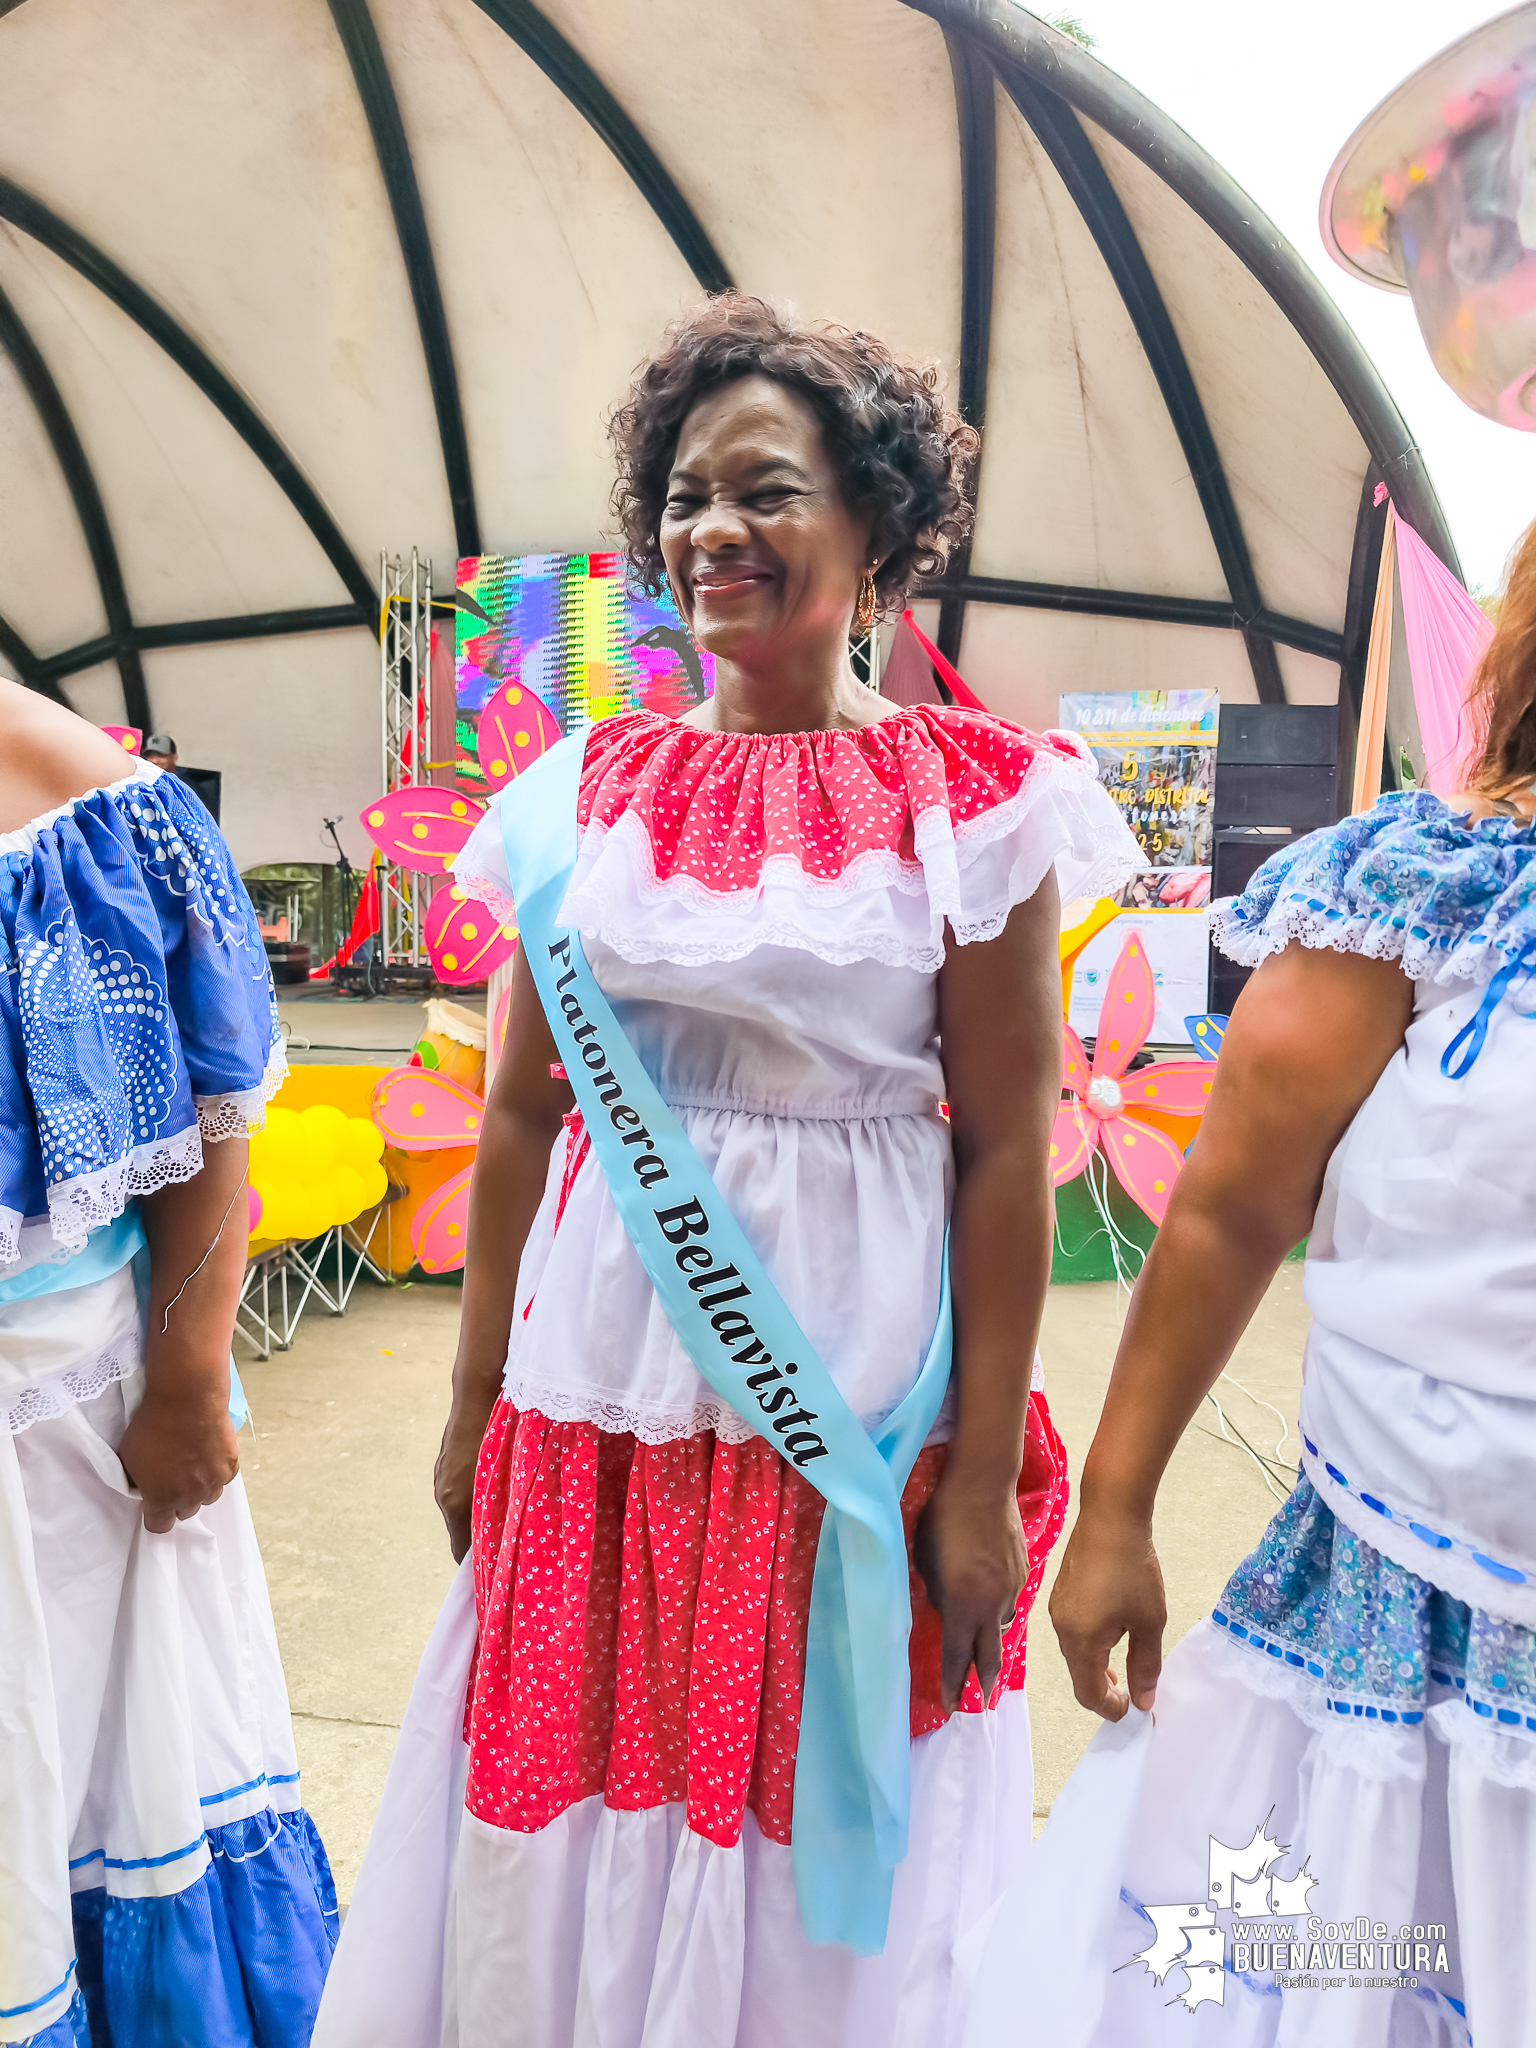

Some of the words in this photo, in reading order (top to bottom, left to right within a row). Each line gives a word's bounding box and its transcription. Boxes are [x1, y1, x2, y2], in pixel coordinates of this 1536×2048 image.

[1120, 706, 1138, 724] de
[1138, 704, 1207, 723] diciembre
[547, 933, 669, 1190] Platonera
[653, 1194, 831, 1467] Bellavista
